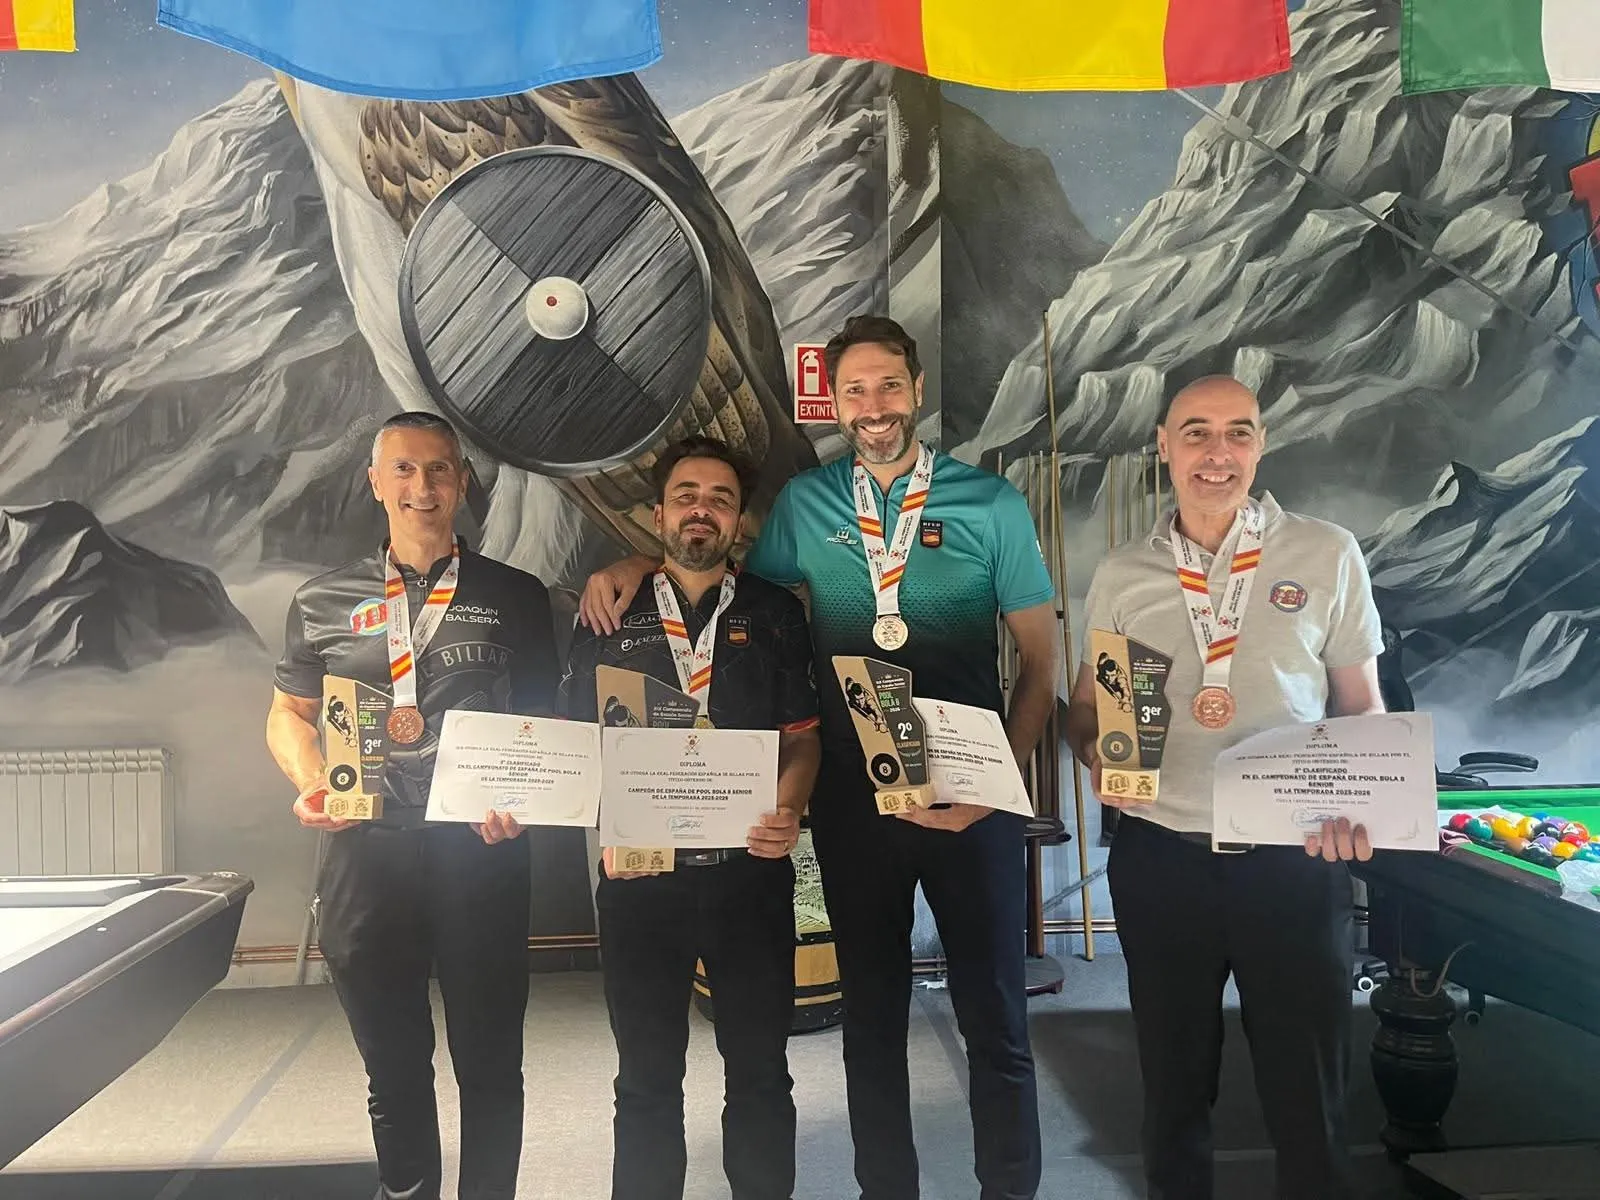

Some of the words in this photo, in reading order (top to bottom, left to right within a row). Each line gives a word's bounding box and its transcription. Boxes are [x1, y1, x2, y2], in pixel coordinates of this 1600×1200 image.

[800, 403, 832, 417] EXTINT
[448, 604, 499, 616] JOAQUIN
[445, 614, 501, 625] BALSERA
[1141, 705, 1163, 724] 3er
[364, 738, 382, 755] 3er
[1113, 743, 1120, 752] 8
[882, 765, 889, 774] 8
[339, 775, 346, 783] 8
